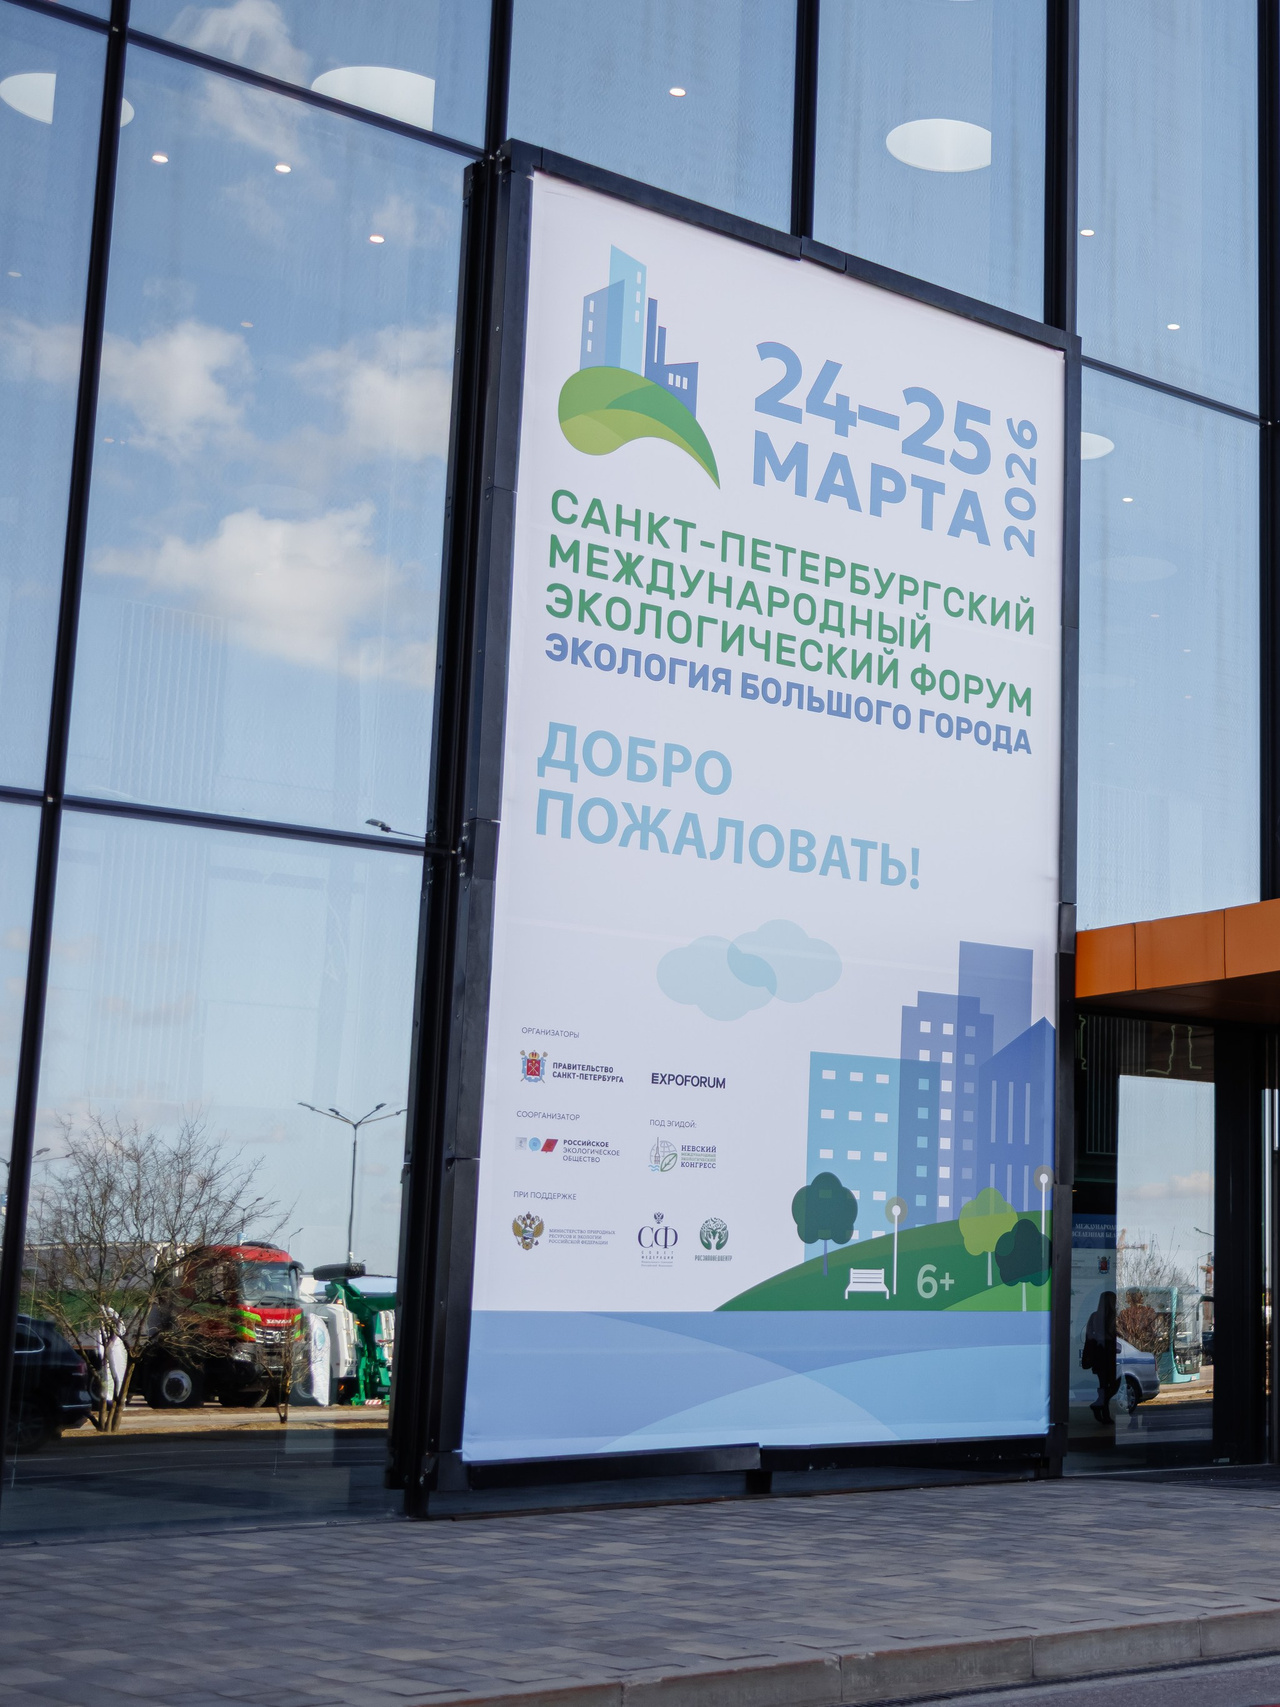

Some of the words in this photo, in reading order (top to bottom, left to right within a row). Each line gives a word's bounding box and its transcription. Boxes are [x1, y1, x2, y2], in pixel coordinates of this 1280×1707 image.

[753, 430, 992, 547] МАРТА
[1003, 418, 1039, 557] 2026
[550, 488, 1035, 635] САНКТ-ПЕТЕРБУРГСКИЙ
[549, 534, 931, 653] МЕЖДУНАРОДНЫЙ
[545, 583, 900, 689] ЭКОЛОГИЧЕСКИЙ
[910, 662, 1032, 717] ФОРУМ
[545, 633, 732, 696] ЭКОЛОГИЯ
[740, 672, 911, 730] БОЛЬШОГО
[919, 701, 1032, 755] ГОРОДА
[536, 721, 732, 796] ДОБРО
[536, 788, 920, 890] ПОЖАЛОВАТЬ!
[521, 1027, 579, 1038] ОРГАНИЗАТОРЫ
[552, 1062, 613, 1073] ПРАВИТЕЛЬСТВО
[552, 1071, 624, 1083] САНКТ-ПЕТЕРБУРГА
[651, 1072, 726, 1089] EXPOFORUM
[516, 1110, 580, 1120] СООРГАНИЗАТОР
[649, 1119, 665, 1127] ПОД
[667, 1120, 697, 1128] ЭГИДОЙ:
[563, 1139, 609, 1147] РОССИЙСКОЕ
[681, 1145, 716, 1153] НЕВСКИЙ
[562, 1147, 620, 1156] ЭКОЛОГИЧЕСКОЕ
[562, 1155, 600, 1163] ОБЩЕСТВО
[680, 1161, 716, 1169] КОНГРЕСС
[513, 1190, 529, 1199] ПРИ
[530, 1191, 577, 1200] ПОДДЕРЖКЕ
[638, 1226, 678, 1249] СФ
[916, 1263, 955, 1299] 6+
